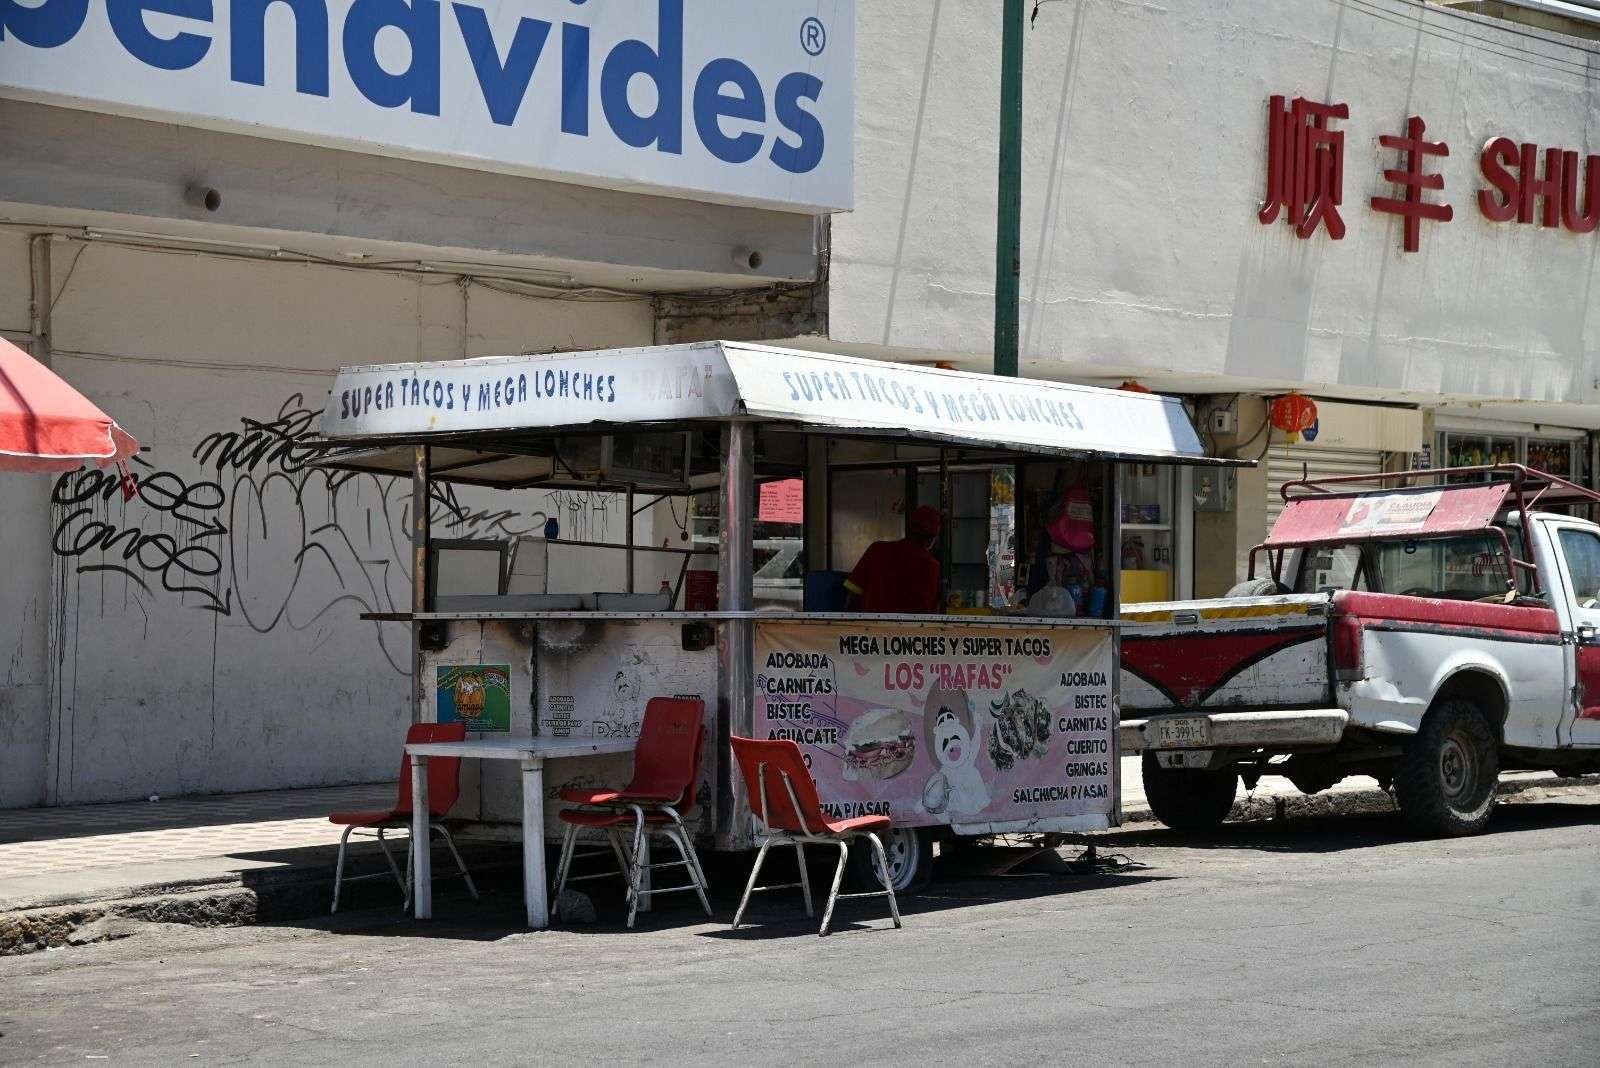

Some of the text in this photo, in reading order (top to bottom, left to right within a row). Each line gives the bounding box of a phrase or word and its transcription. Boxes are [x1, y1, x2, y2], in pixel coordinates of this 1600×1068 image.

[0, 0, 826, 175] enavides
[1258, 94, 1454, 253] 顺丰
[341, 380, 394, 420] SUPER
[400, 377, 454, 410] TACOS
[462, 385, 470, 412] Y
[478, 373, 527, 411] MEGA
[535, 369, 616, 403] LONCHES
[783, 370, 1084, 430] SUPER TACOS Y MEGA LONCHES
[839, 635, 1051, 657] MEGA LONCHES Y SUPER TACOS
[766, 652, 830, 669] ADOBADA
[884, 662, 925, 691] LOS
[1060, 672, 1107, 687] ADOBADA
[766, 677, 832, 694] CARNITAS
[1074, 694, 1107, 709] BISTEC
[766, 702, 812, 720] BISTEC
[1058, 717, 1108, 733] CARNITAS
[767, 728, 838, 745] AGUACATE
[1066, 739, 1108, 755] CUERITO
[1065, 761, 1108, 778] GRINGAS
[1013, 784, 1108, 805] SALCHICHA P/ASAR
